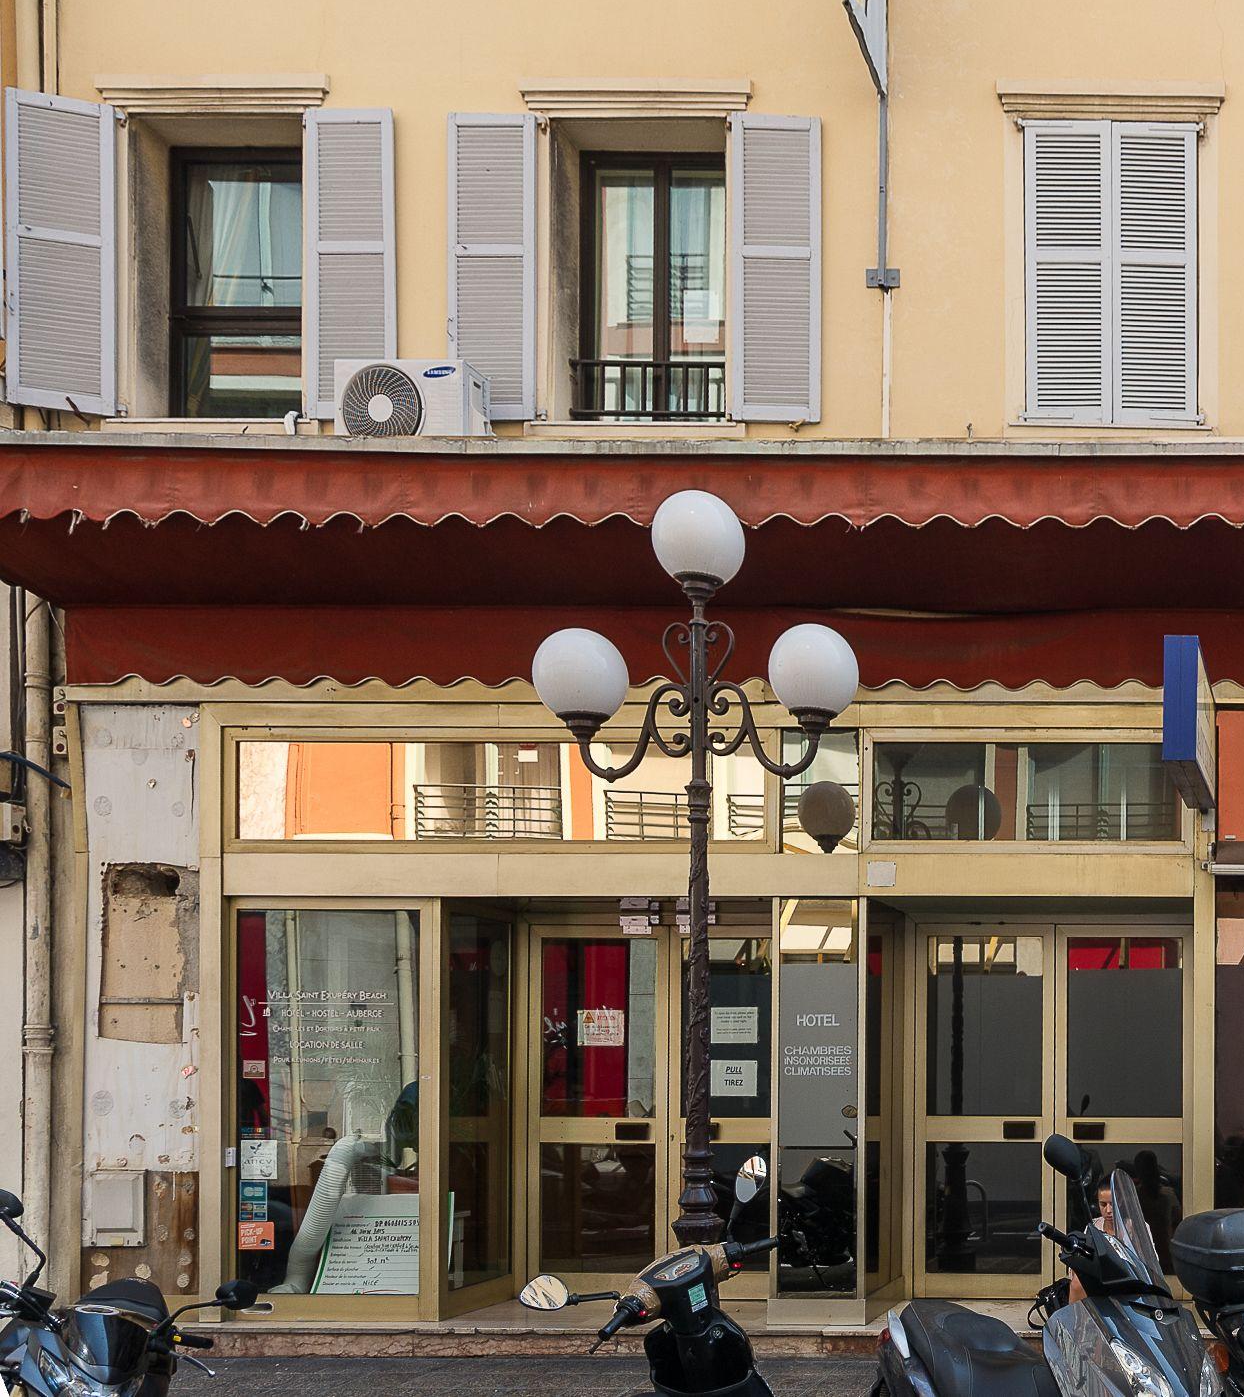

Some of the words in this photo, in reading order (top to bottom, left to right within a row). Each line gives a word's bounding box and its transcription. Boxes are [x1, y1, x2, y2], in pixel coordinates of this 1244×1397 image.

[295, 990, 319, 1001] SAINT
[321, 990, 357, 1001] EXUPÉRY
[360, 990, 386, 1000] BEACH
[312, 1009, 339, 1017] HOSTEL
[346, 1009, 383, 1018] AUBERGE
[796, 1014, 840, 1027] HOTEL
[289, 1040, 330, 1049] LOCATION
[331, 1041, 340, 1049] DE
[341, 1041, 364, 1049] SALLE
[784, 1046, 852, 1055] CHAMBRES
[784, 1056, 850, 1065] INSONORISEES
[784, 1066, 852, 1076] CLIMATISEES
[240, 1227, 264, 1237] PICK-UP
